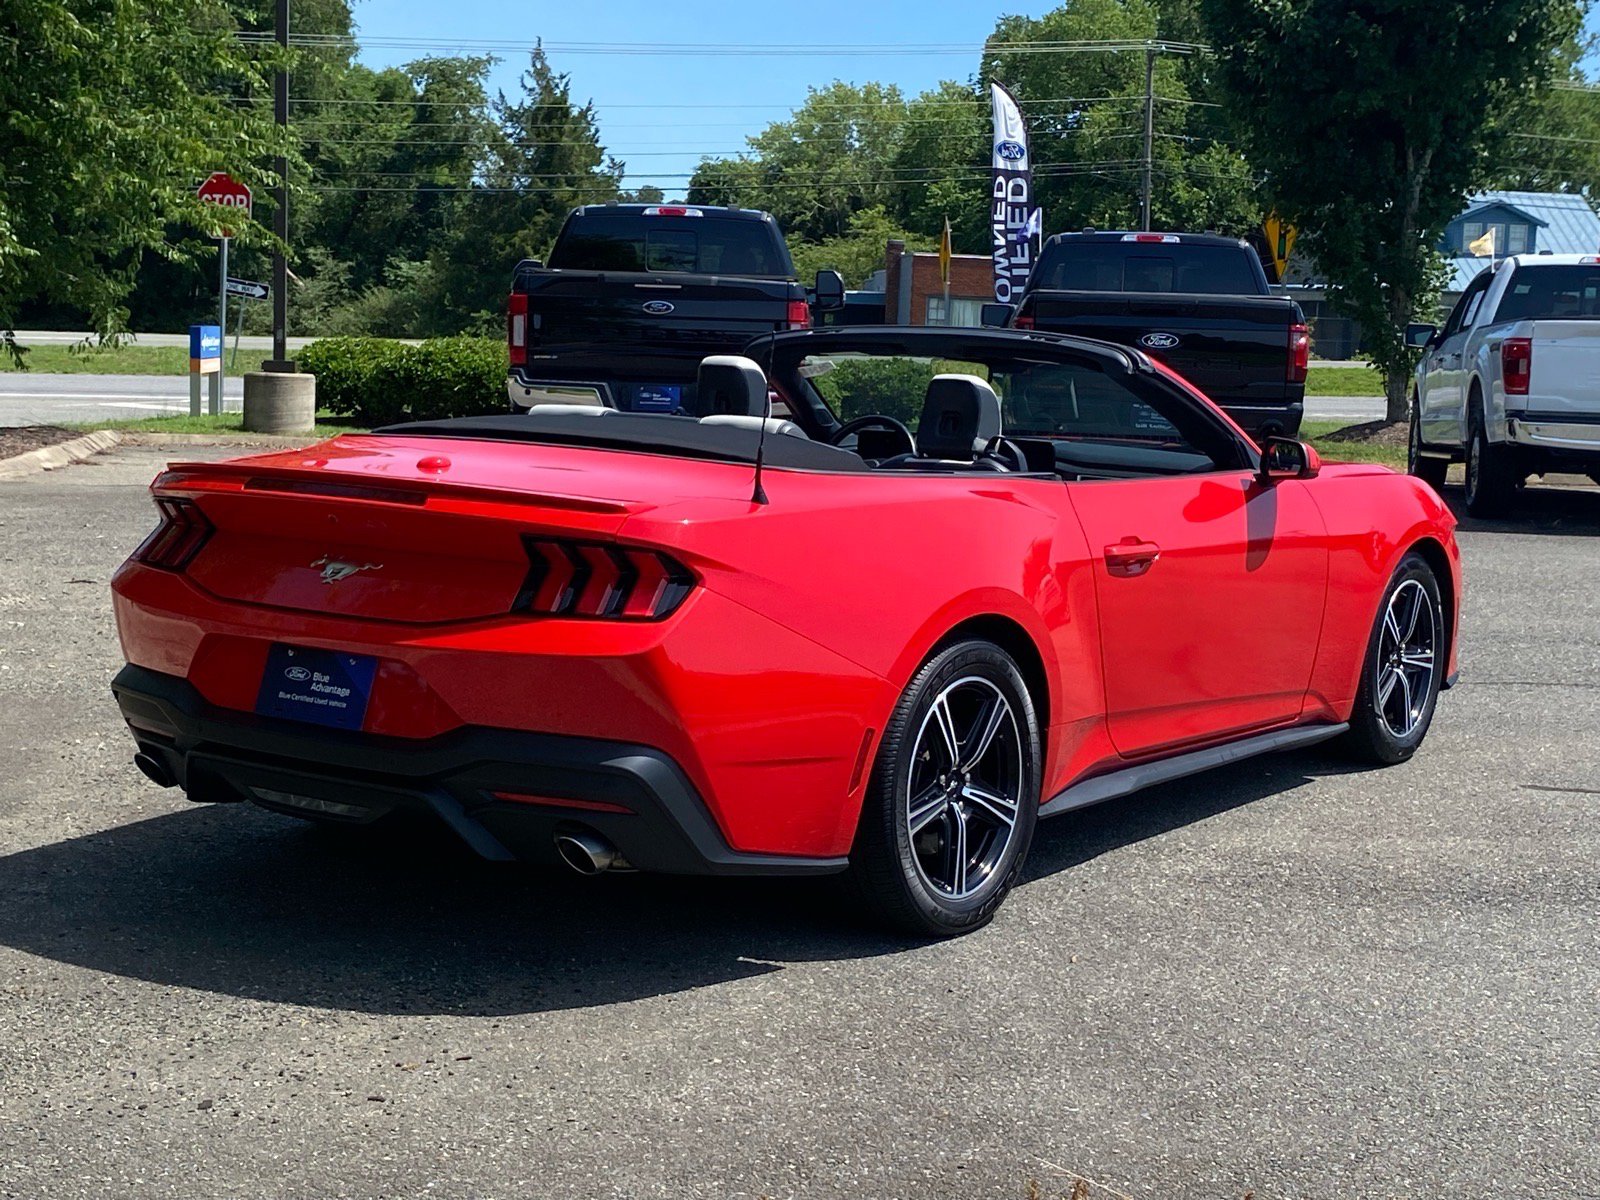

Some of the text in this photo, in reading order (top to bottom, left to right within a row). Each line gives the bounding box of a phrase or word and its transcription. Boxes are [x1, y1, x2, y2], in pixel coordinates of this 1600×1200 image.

[289, 669, 330, 683] Ford Blue
[310, 682, 351, 697] Advantage
[278, 691, 291, 700] Blue
[291, 693, 314, 704] Certified
[314, 697, 328, 706] Used
